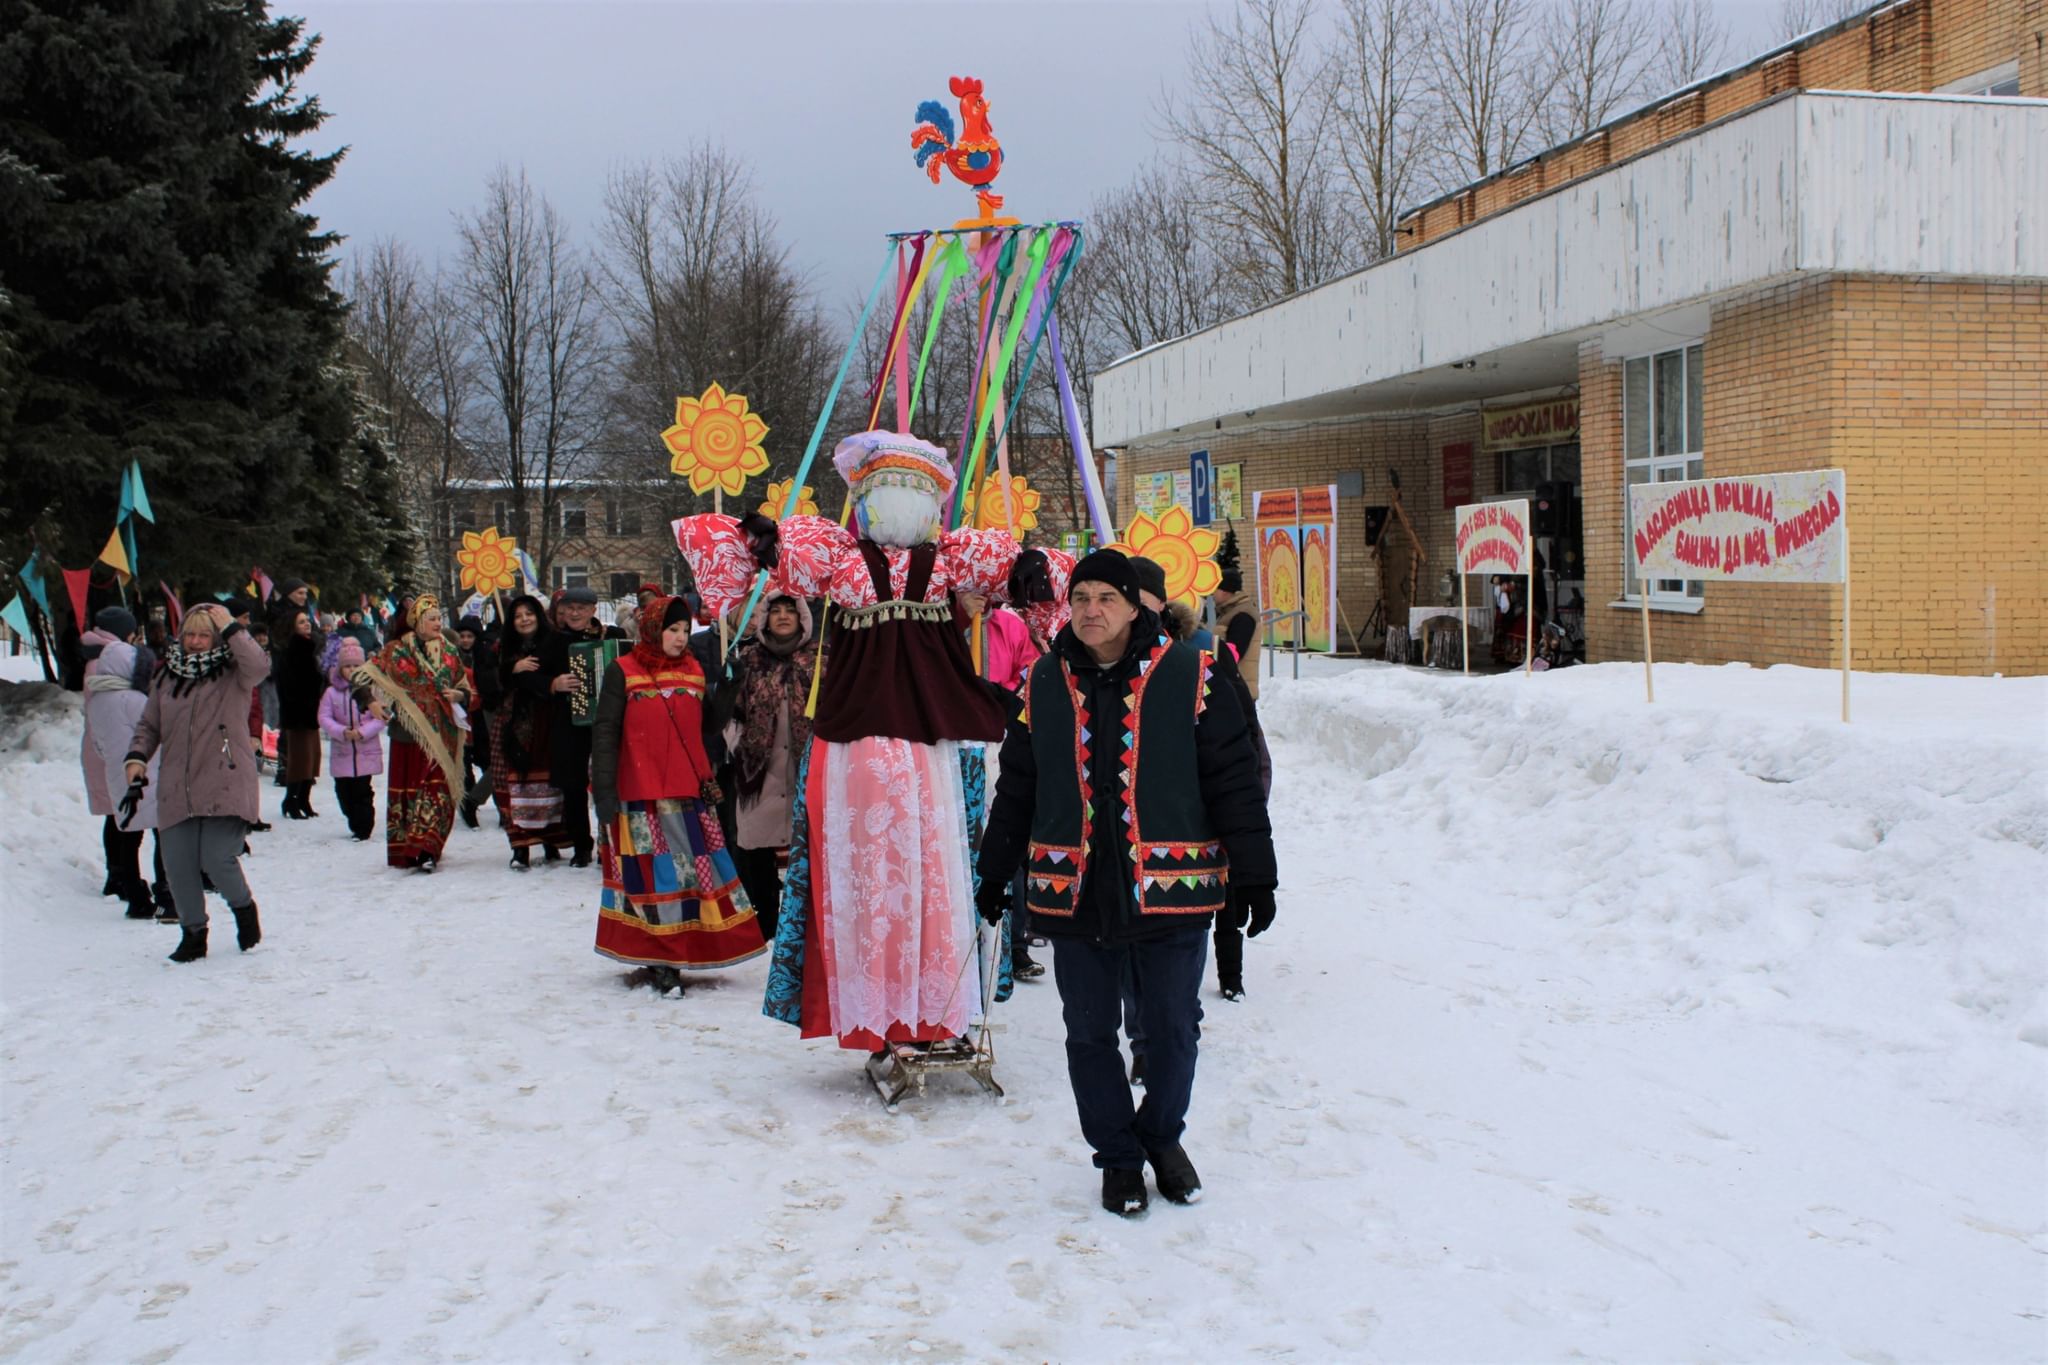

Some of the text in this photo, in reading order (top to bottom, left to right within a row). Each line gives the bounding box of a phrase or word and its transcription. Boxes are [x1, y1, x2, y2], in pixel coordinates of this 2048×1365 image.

[1488, 406, 1551, 440] ШИРОКАЯ
[1634, 482, 1778, 564] МАСЛЕНИЦА ПРИШЛА,
[1675, 490, 1841, 574] БЛИНЫ ДА МЁД ПРИНЕСЛА
